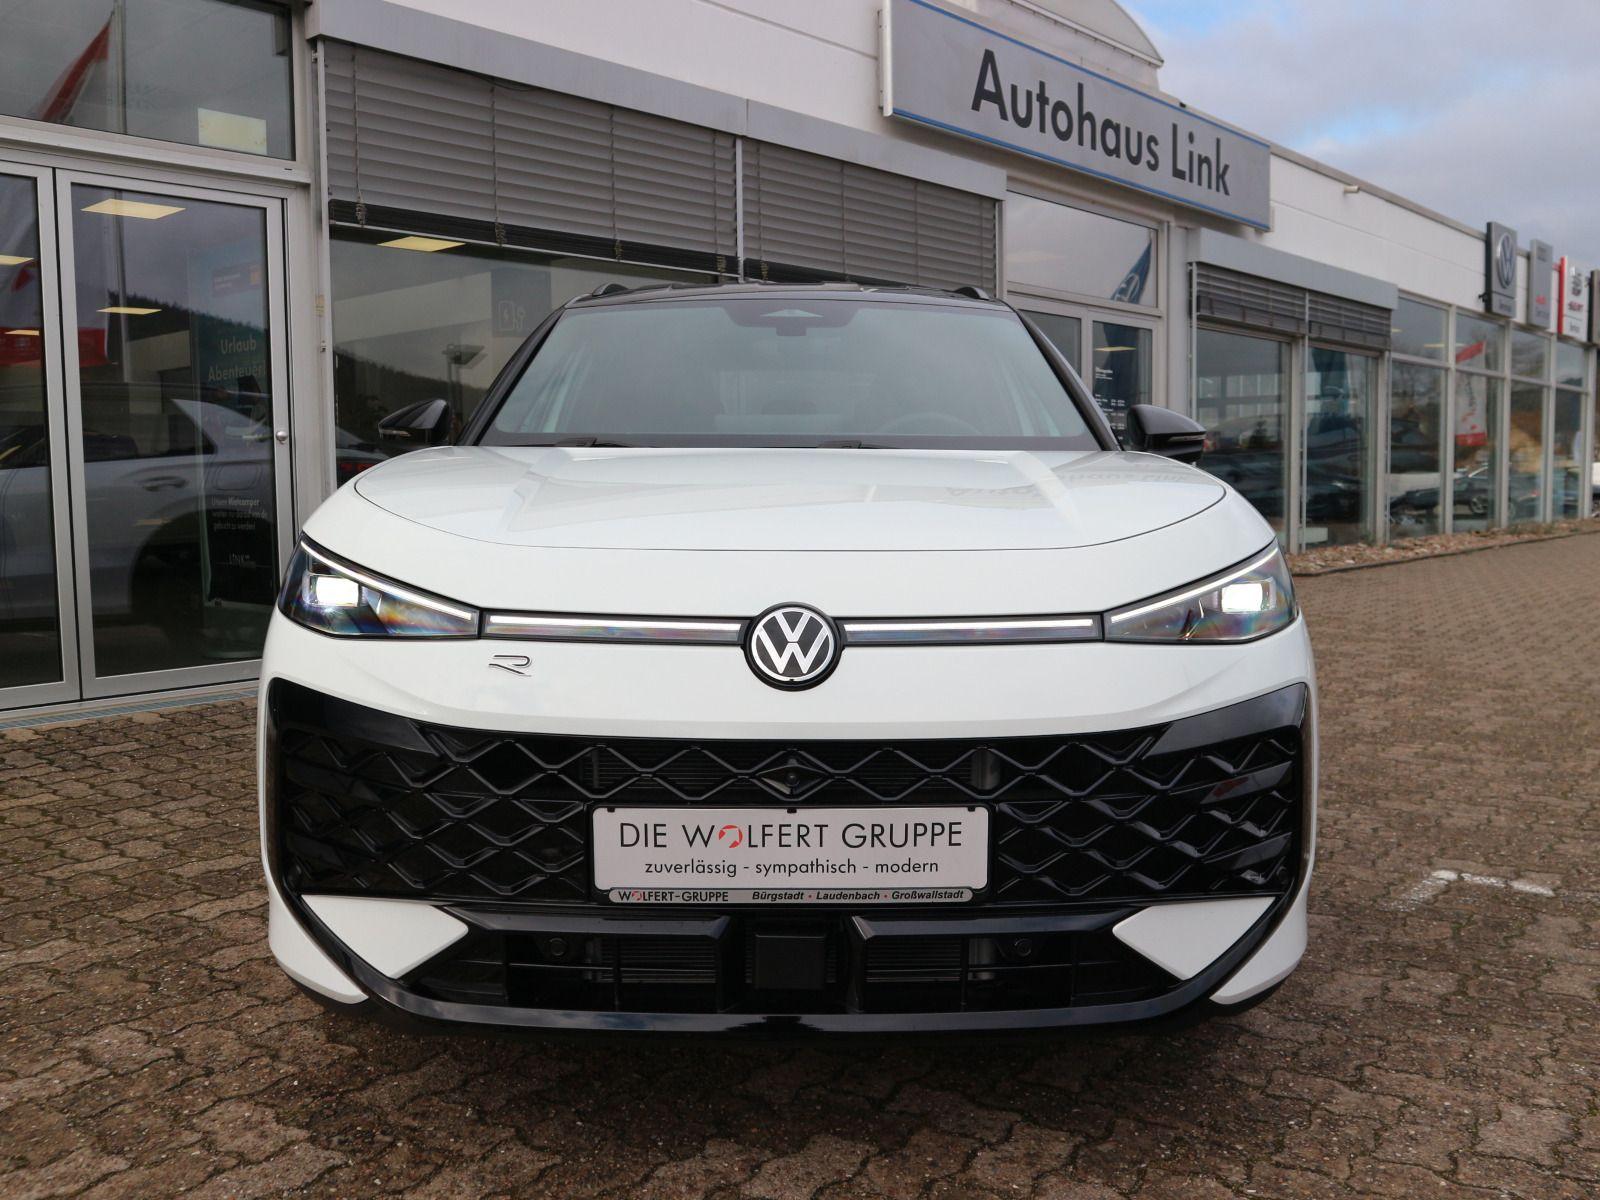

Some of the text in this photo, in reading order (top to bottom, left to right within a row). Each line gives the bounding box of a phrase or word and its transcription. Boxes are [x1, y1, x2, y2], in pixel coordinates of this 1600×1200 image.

[971, 48, 1231, 196] Autohaus Link
[220, 334, 257, 355] Urlaub
[751, 607, 835, 682] VW
[620, 821, 963, 849] DIE WOLFERT GRUPPE
[645, 858, 737, 878] zuverlässig
[755, 858, 856, 878] sympathisch
[875, 857, 939, 873] modern
[618, 889, 964, 902] WOLFERT-GRUPPE Bürgstadt Laudenbach Großwallstadt
